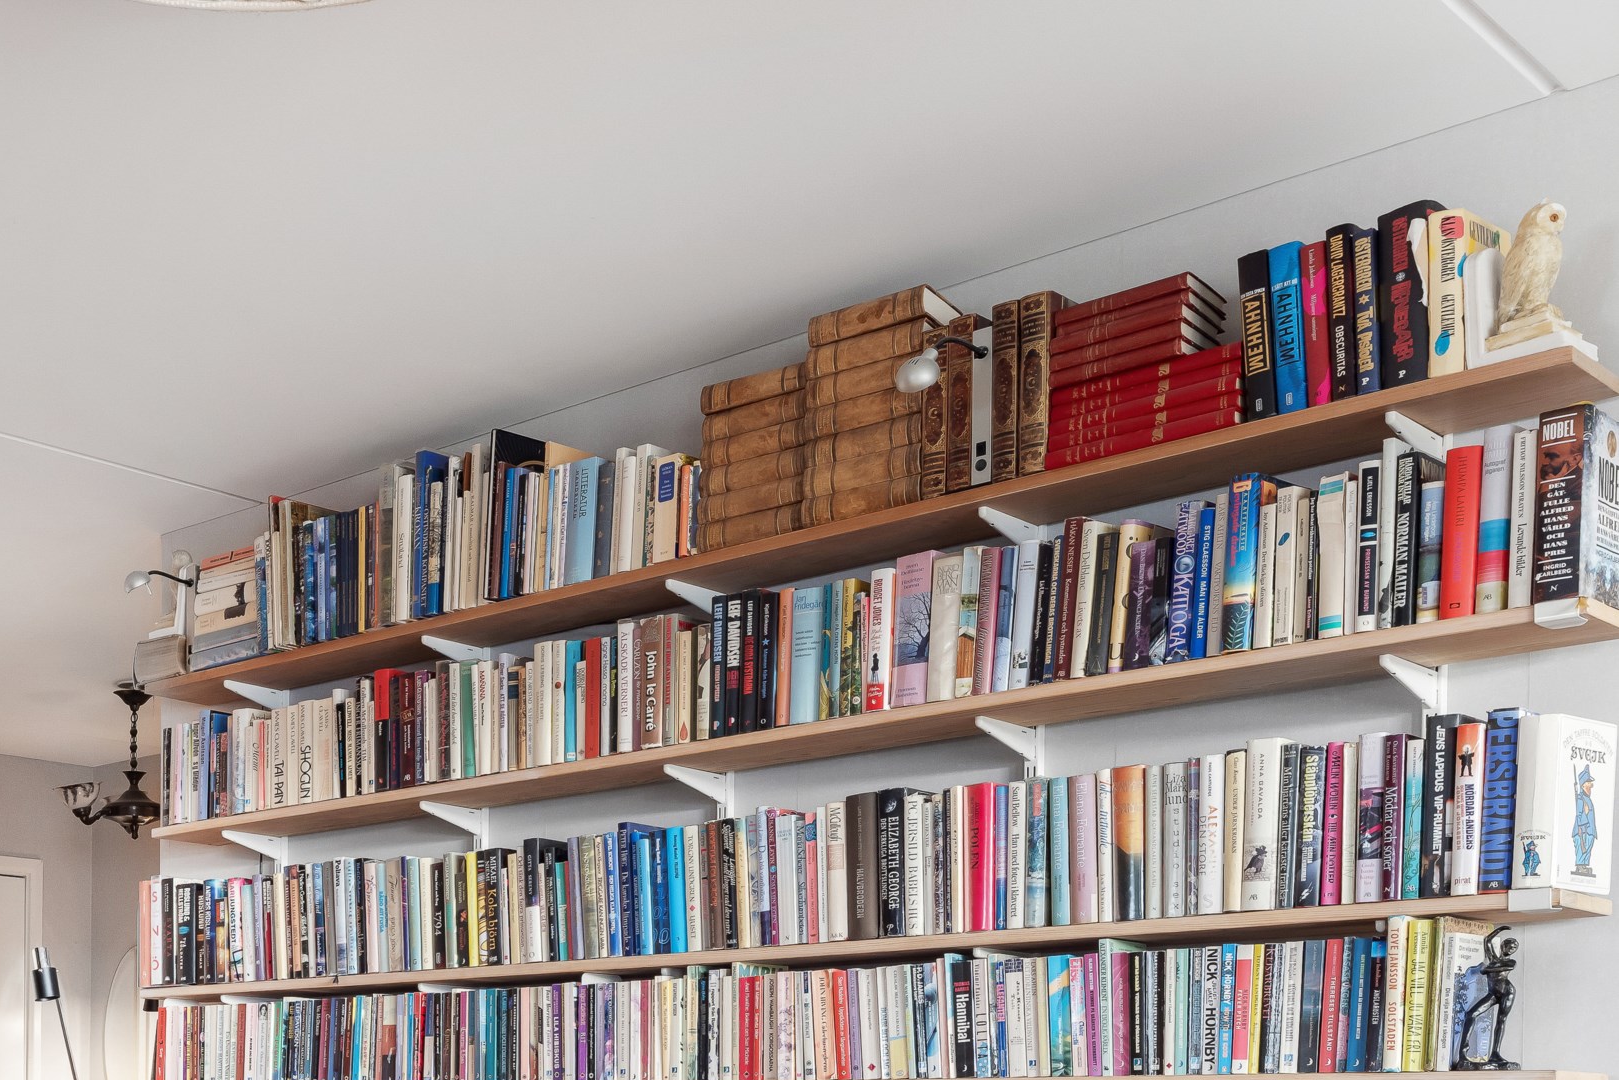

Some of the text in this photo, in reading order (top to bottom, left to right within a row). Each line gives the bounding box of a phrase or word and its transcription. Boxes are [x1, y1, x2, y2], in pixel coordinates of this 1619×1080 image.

[1440, 217, 1457, 338] KLAS ÖSTERGREN GENTLEMEN
[1330, 235, 1346, 377] DAVID LAGERCRANTZ OBSCURITAS
[1542, 419, 1575, 442] NOBEL
[578, 468, 589, 517] LITTERATUR
[1455, 456, 1468, 527] JHUMPA LAHIRI
[1540, 505, 1574, 516] ALFRED
[1544, 515, 1568, 524] HANS
[1546, 532, 1564, 540] OCH
[1052, 538, 1061, 581] SVENSKARNA
[1201, 542, 1210, 577] CLAESSON
[1394, 512, 1410, 608] NORMAN MAILER
[1543, 540, 1568, 549] HANS
[1544, 548, 1566, 557] PRIS
[420, 559, 428, 608] KOMPANIET
[872, 578, 883, 626] BRIDGET JONES
[1058, 520, 1078, 664] HÅKAN NESSER Kommissarien och tystnaden
[1076, 528, 1092, 638] Sven Delblanc Livets ax
[713, 603, 723, 662] LEIF DAVIDSEN
[727, 600, 741, 667] LEIF DAVIDSEN
[1169, 572, 1194, 649] KATTÖGA
[1197, 616, 1205, 639] ÅLDER
[1045, 618, 1055, 664] BROTTSLINGAR
[479, 670, 487, 700] MAÑANA
[645, 651, 657, 731] John le Carré
[274, 760, 284, 804] TAI-PAN
[300, 745, 311, 799] SHOGUN
[1012, 786, 1020, 802] Saul
[1432, 725, 1445, 855] JENS LAPIDUS VIP-RUMMET
[1012, 803, 1020, 827] Bellow
[1465, 784, 1476, 850] MÖRDAR-ANDERS
[1479, 712, 1517, 885] PERSBRANDT
[971, 827, 979, 869] POLEN
[1011, 833, 1020, 849] Han
[1053, 783, 1064, 870] Elena Ferrante
[1076, 782, 1087, 868] Elena Ferrante
[887, 816, 900, 910] ELIZABETH GEORGE
[1011, 850, 1020, 866] med
[1011, 867, 1020, 885] foten
[229, 899, 237, 943] JUNGSTEDT
[434, 911, 443, 936] 1794
[487, 889, 496, 917] Koka
[1010, 889, 1020, 917] klaveret
[486, 919, 498, 950] björn
[1223, 953, 1233, 1005] NICK HORNBY
[1387, 928, 1399, 1051] TOVE JANSSON SOLSTADEN
[955, 994, 970, 1043] Hannibal
[1204, 949, 1218, 1064] NICK HORNBY
[1326, 976, 1337, 1052] THERESES TILLSTÅND
[975, 1013, 987, 1059] LOLITA
